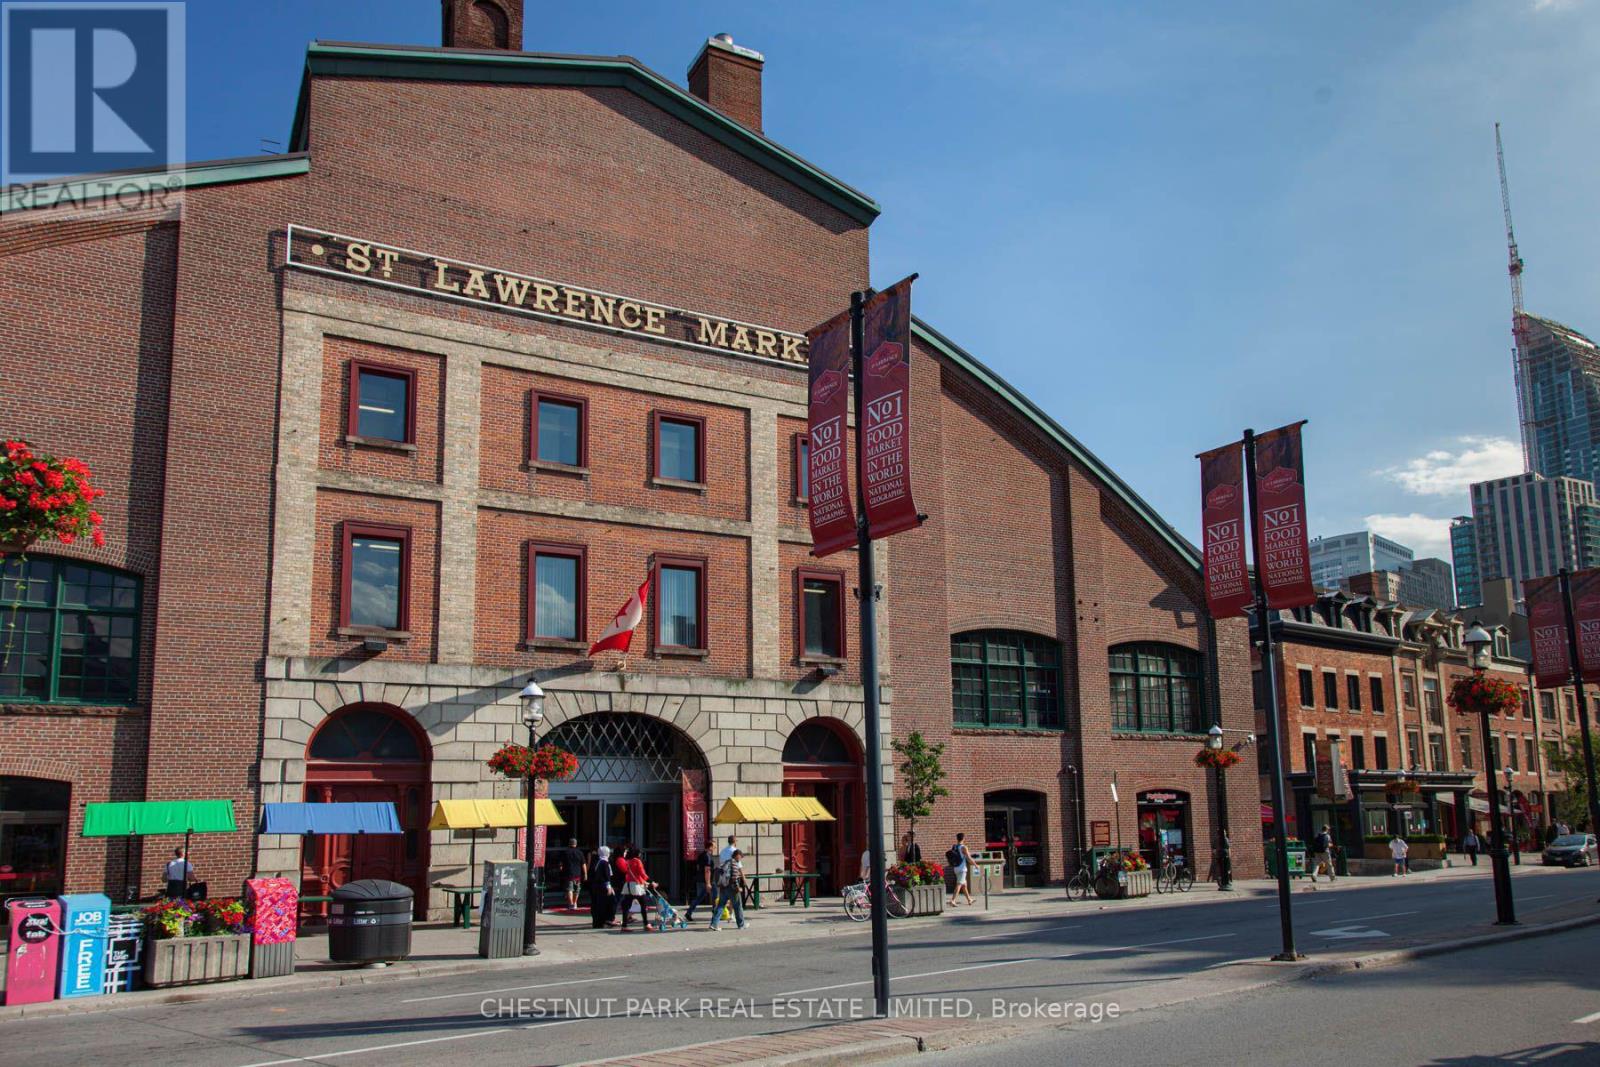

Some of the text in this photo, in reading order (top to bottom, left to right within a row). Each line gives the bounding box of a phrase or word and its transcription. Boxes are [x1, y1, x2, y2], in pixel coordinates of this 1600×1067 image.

[434, 259, 666, 335] LAWRENCE
[698, 316, 809, 363] MARK
[867, 422, 903, 447] FOOD
[867, 436, 903, 458] MARKET
[811, 446, 841, 470] FOOD
[867, 451, 903, 474] IN THE
[811, 460, 841, 480] MARKET
[868, 463, 904, 484] WORLD
[812, 473, 842, 495] IN THE
[868, 479, 904, 497] NATIONAL
[812, 485, 843, 505] WORLD
[870, 489, 905, 505] GEOGRAPHIC
[813, 500, 844, 517] NATIONAL
[814, 509, 846, 525] GEOGRAPHIC
[1264, 526, 1301, 544] FOOD
[1264, 537, 1301, 551] MARKET
[1208, 541, 1240, 558] FOOD
[1208, 551, 1240, 564] MARKET
[1265, 547, 1302, 562] IN THE
[1209, 560, 1241, 576] IN THE
[1266, 557, 1303, 571] WORLD
[1210, 570, 1242, 583] WORLD
[76, 911, 102, 922] JOB
[76, 938, 94, 989] FREE
